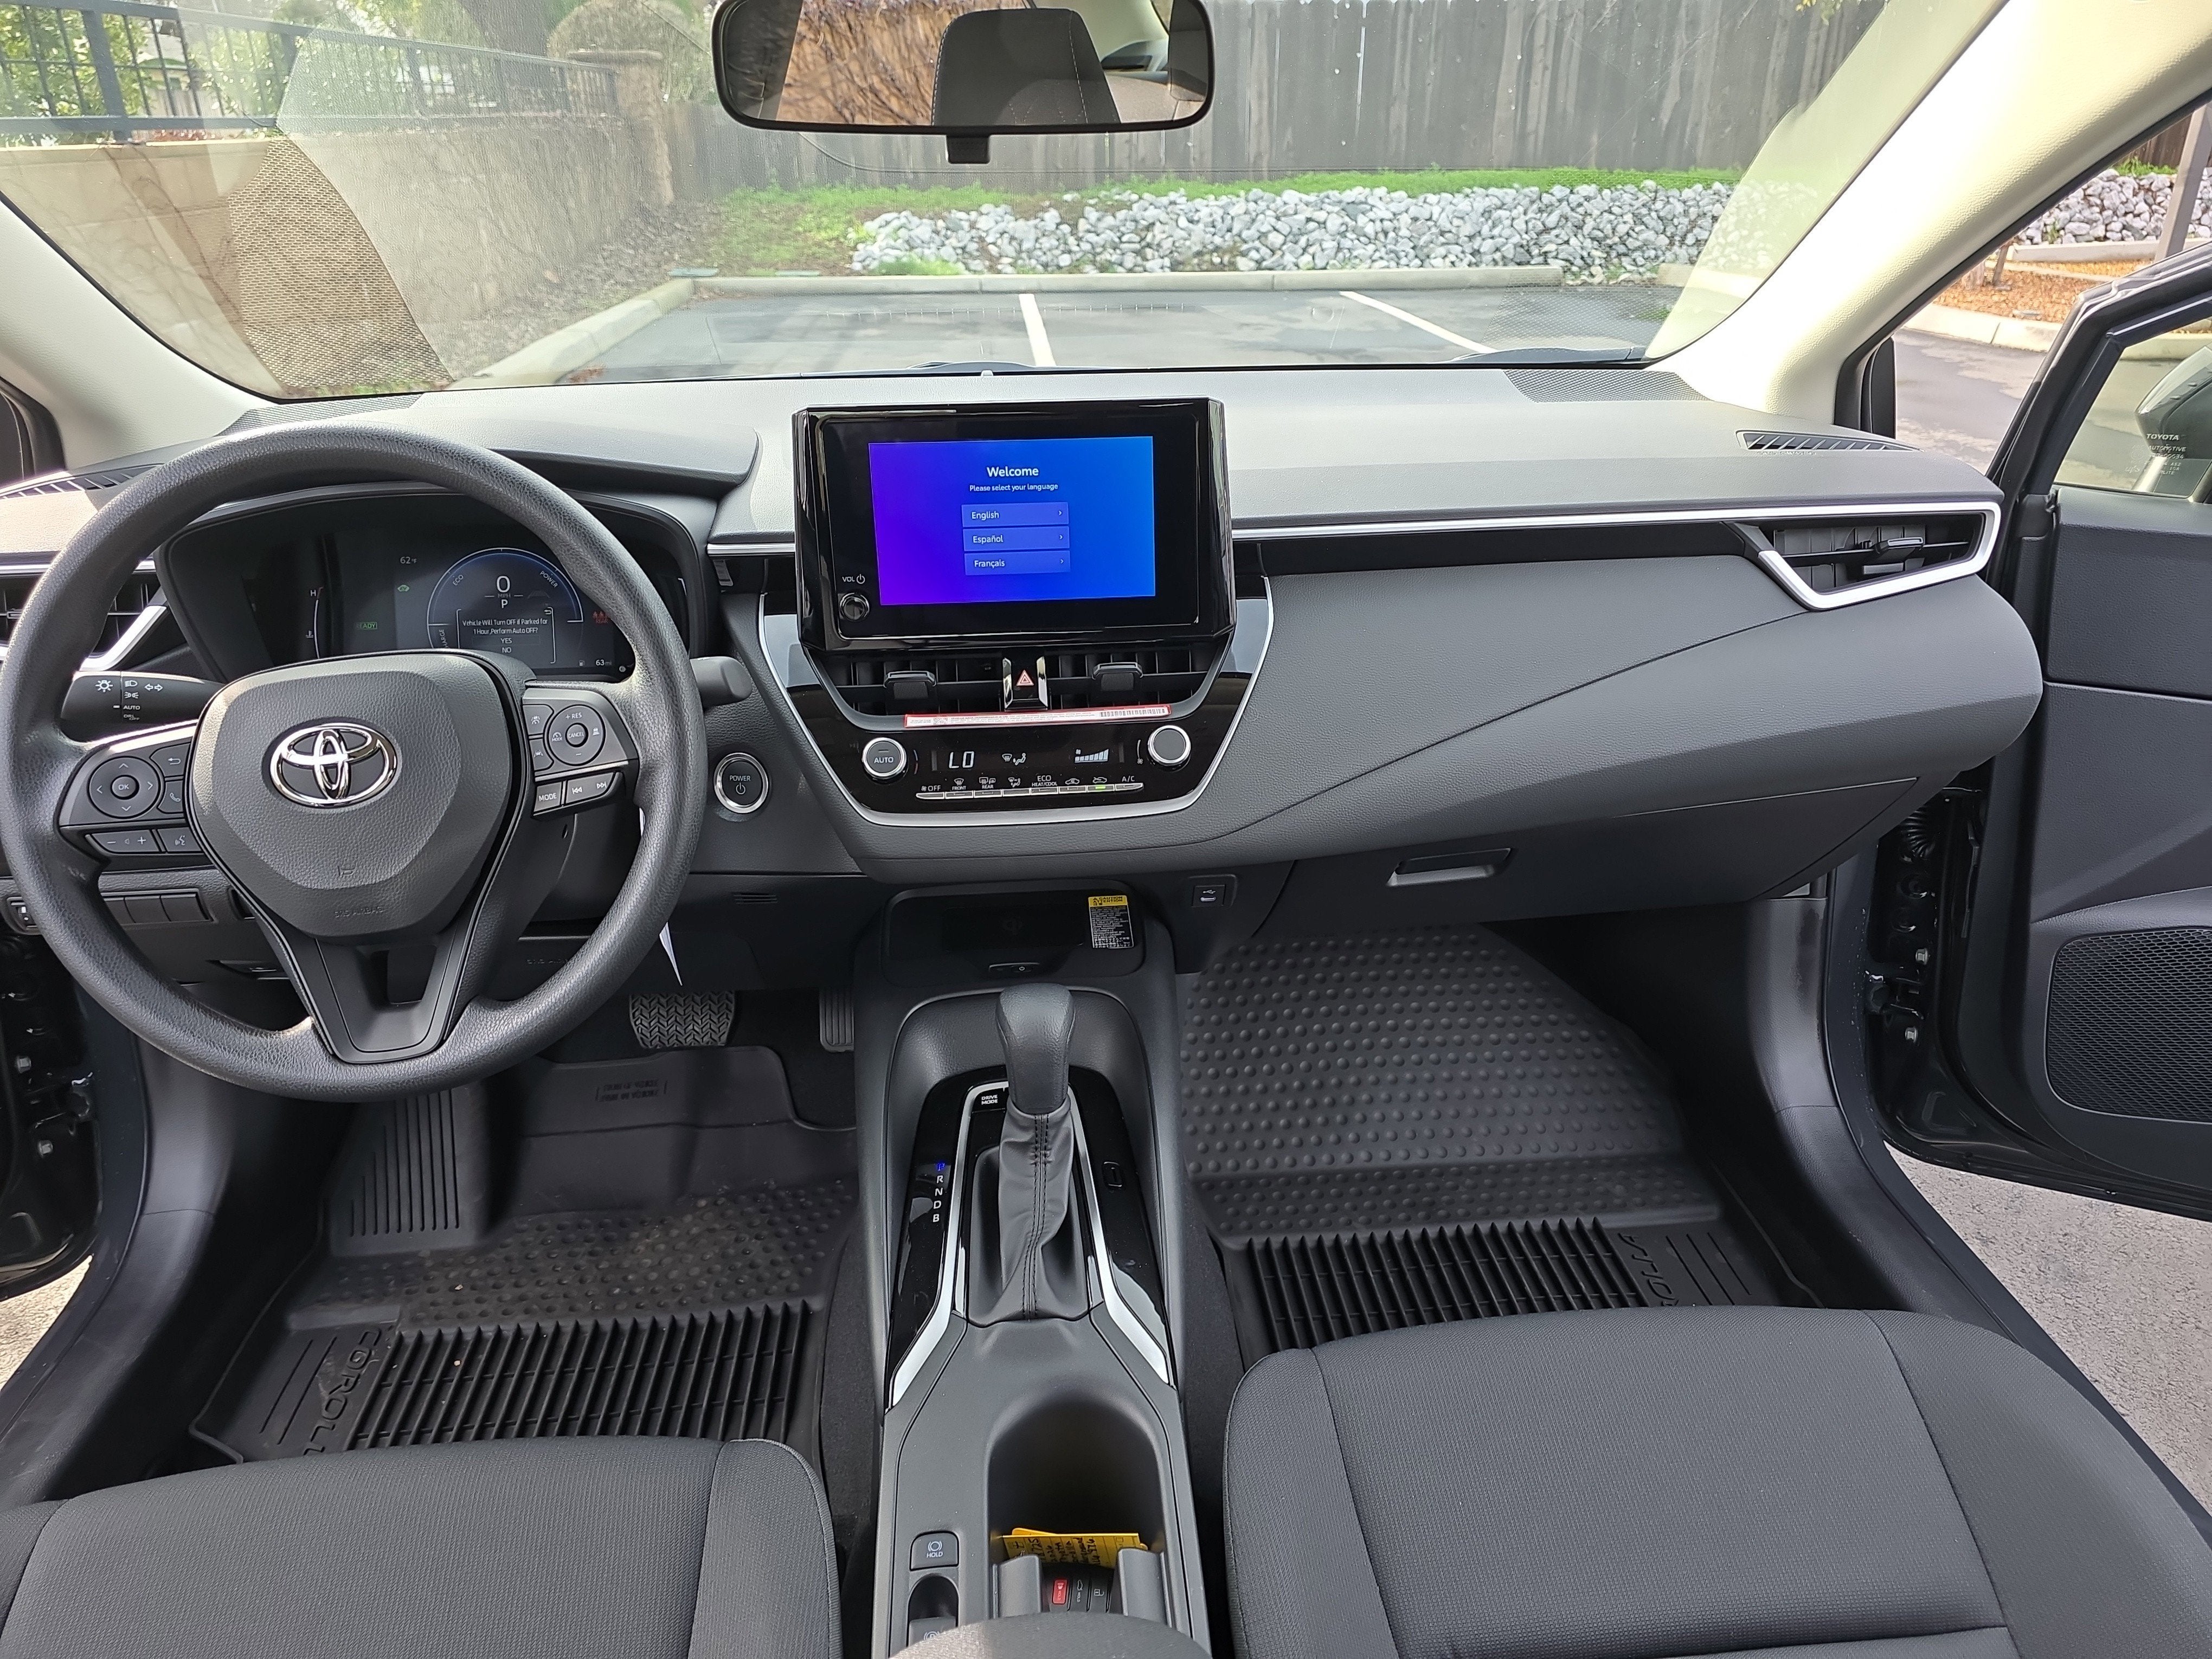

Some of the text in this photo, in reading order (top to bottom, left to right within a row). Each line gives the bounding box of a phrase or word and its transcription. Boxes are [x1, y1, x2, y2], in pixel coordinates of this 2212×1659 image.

[986, 466, 1039, 477] Welcome
[1027, 483, 1058, 491] language
[971, 510, 1000, 521] English
[973, 534, 1004, 544] Español
[974, 558, 1005, 569] Français
[452, 574, 464, 586] ECO
[496, 575, 511, 593] 0
[539, 570, 558, 588] POWER
[501, 599, 508, 609] P
[439, 628, 448, 648] HARGE
[873, 756, 895, 764] AUTO
[538, 793, 557, 802] MODE
[936, 1175, 944, 1184] R
[934, 1188, 943, 1196] N
[933, 1200, 942, 1209] D
[933, 1214, 940, 1223] B
